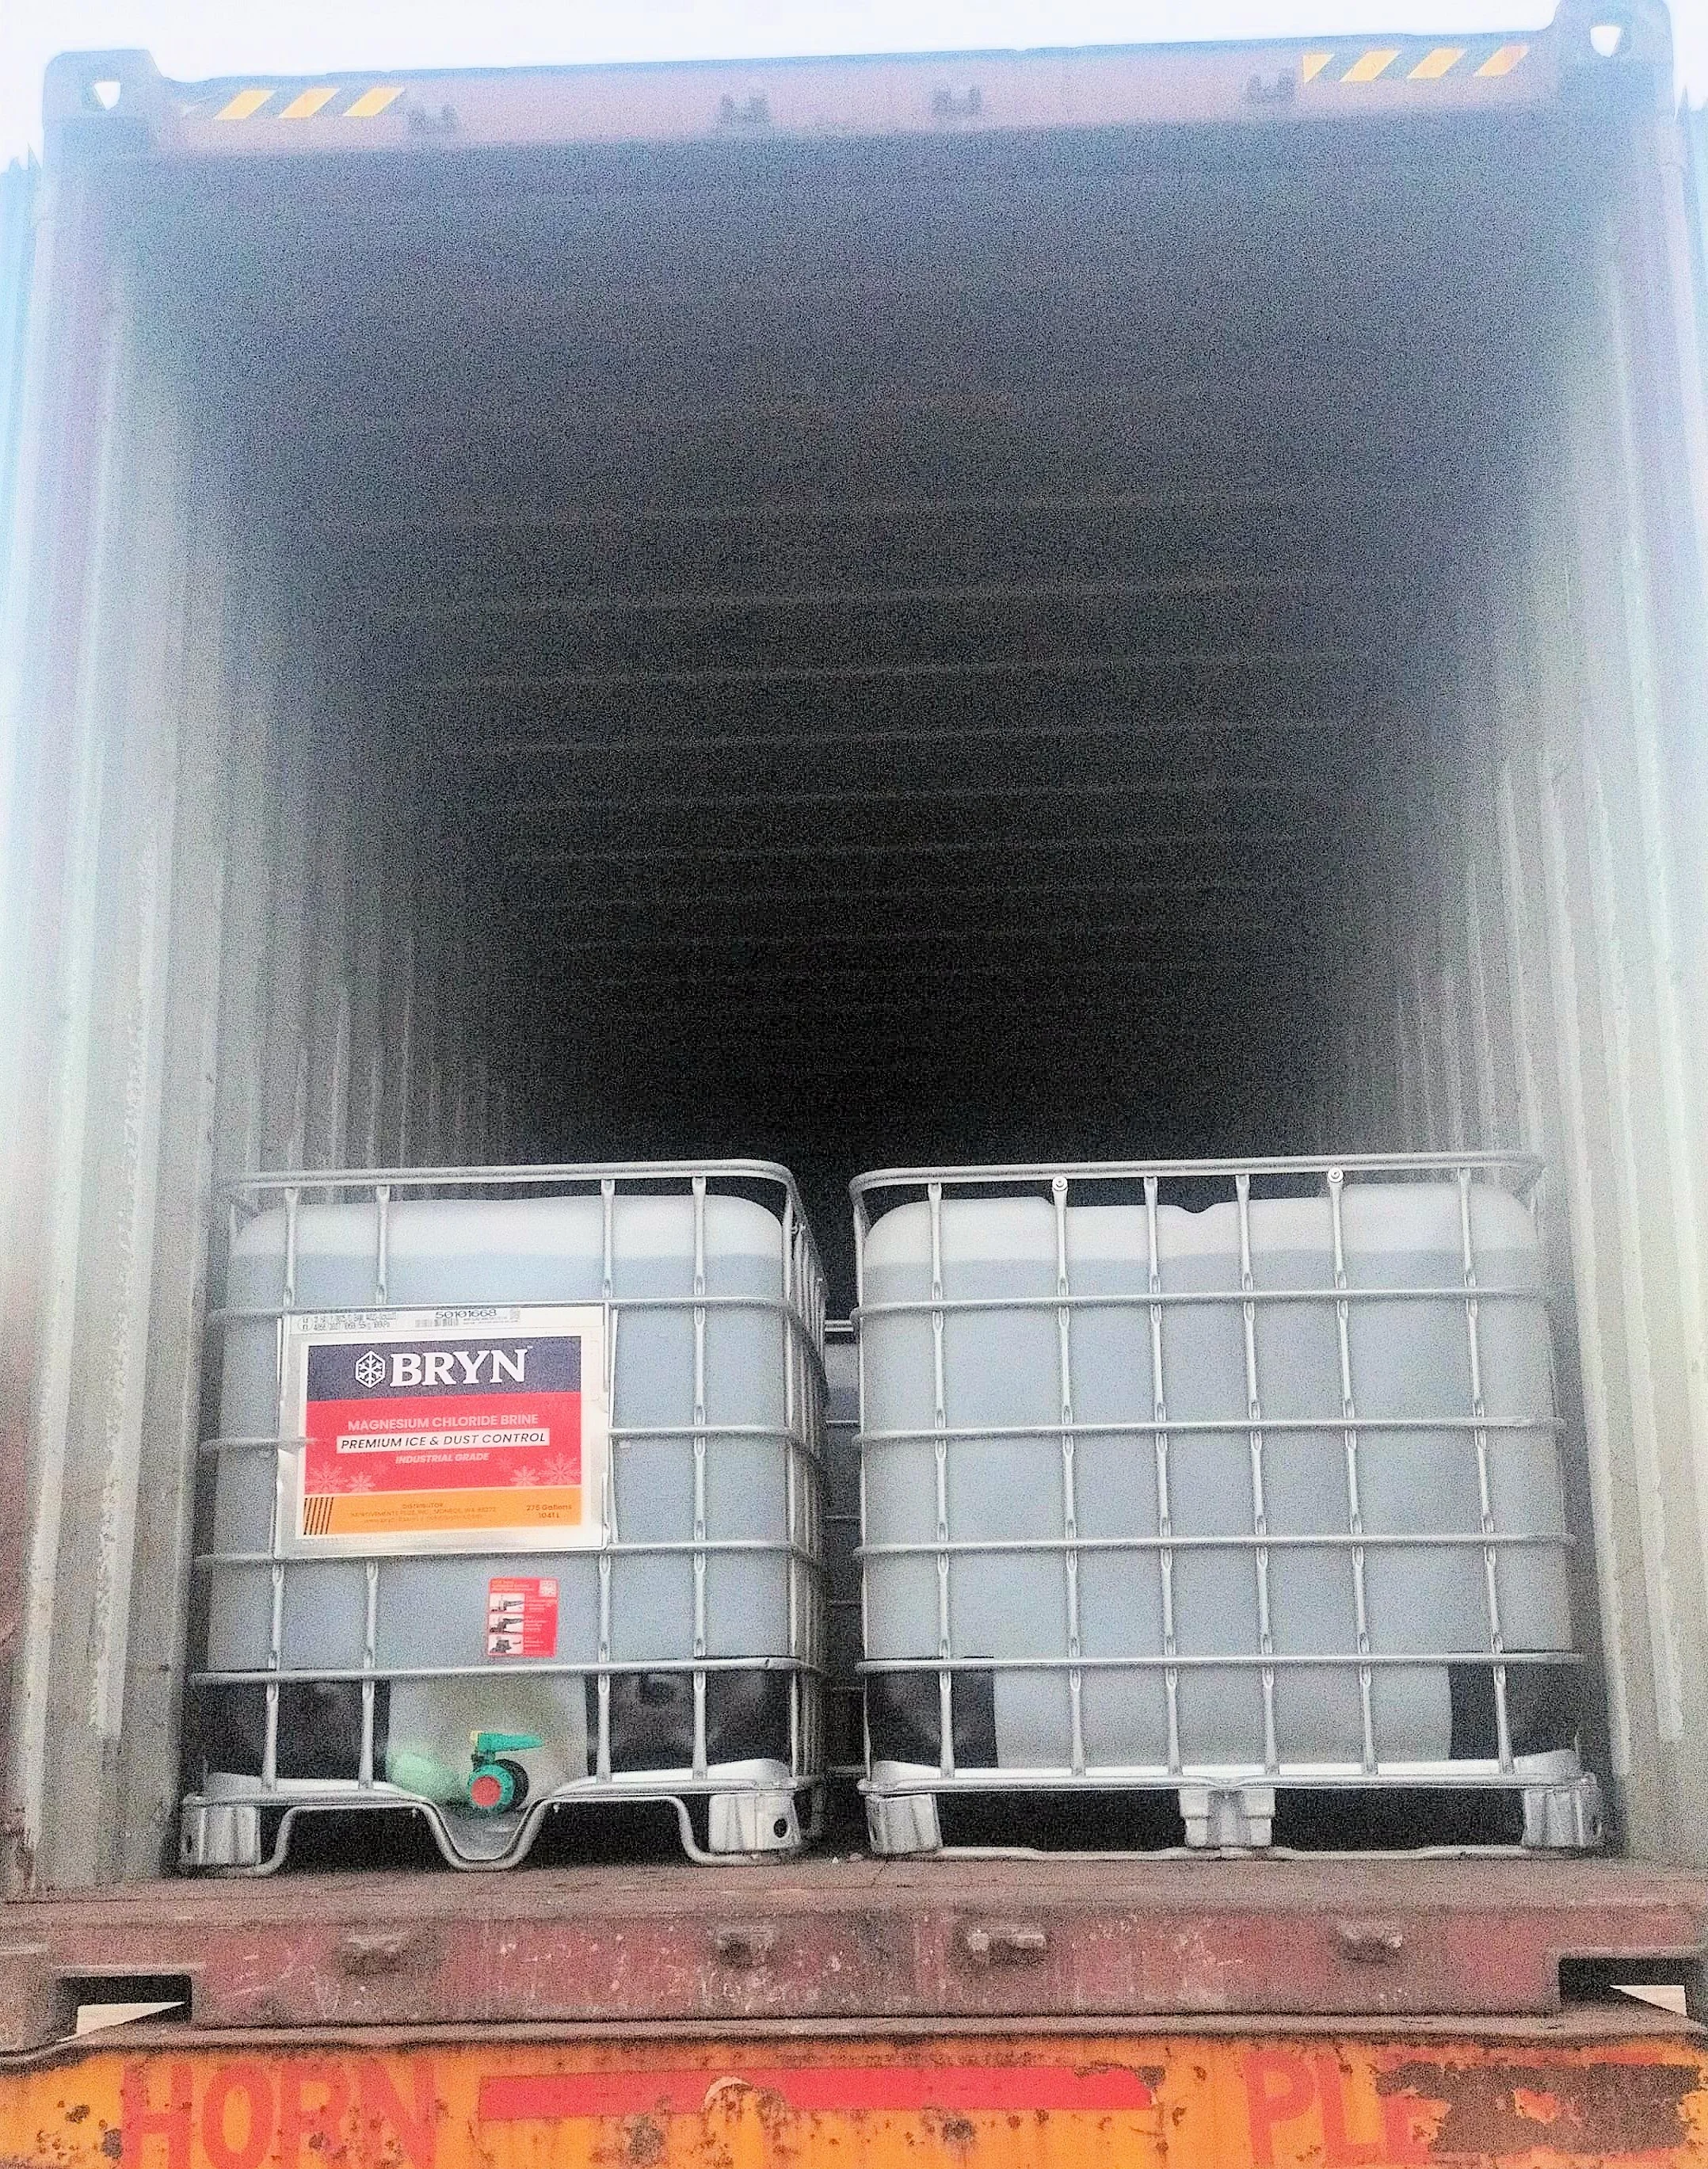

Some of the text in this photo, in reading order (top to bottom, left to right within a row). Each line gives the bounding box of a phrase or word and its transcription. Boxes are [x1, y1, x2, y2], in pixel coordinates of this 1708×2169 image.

[435, 1309, 497, 1319] 50101668
[390, 1349, 528, 1387] BRYN
[348, 1413, 539, 1431] MAGNESIUM CHLORIDE BRINE
[341, 1432, 546, 1449] PREMIUM ICE & DUST CONTROL
[395, 1452, 490, 1464] INDUSTRIAL GRADE
[120, 2057, 436, 2169] HORN
